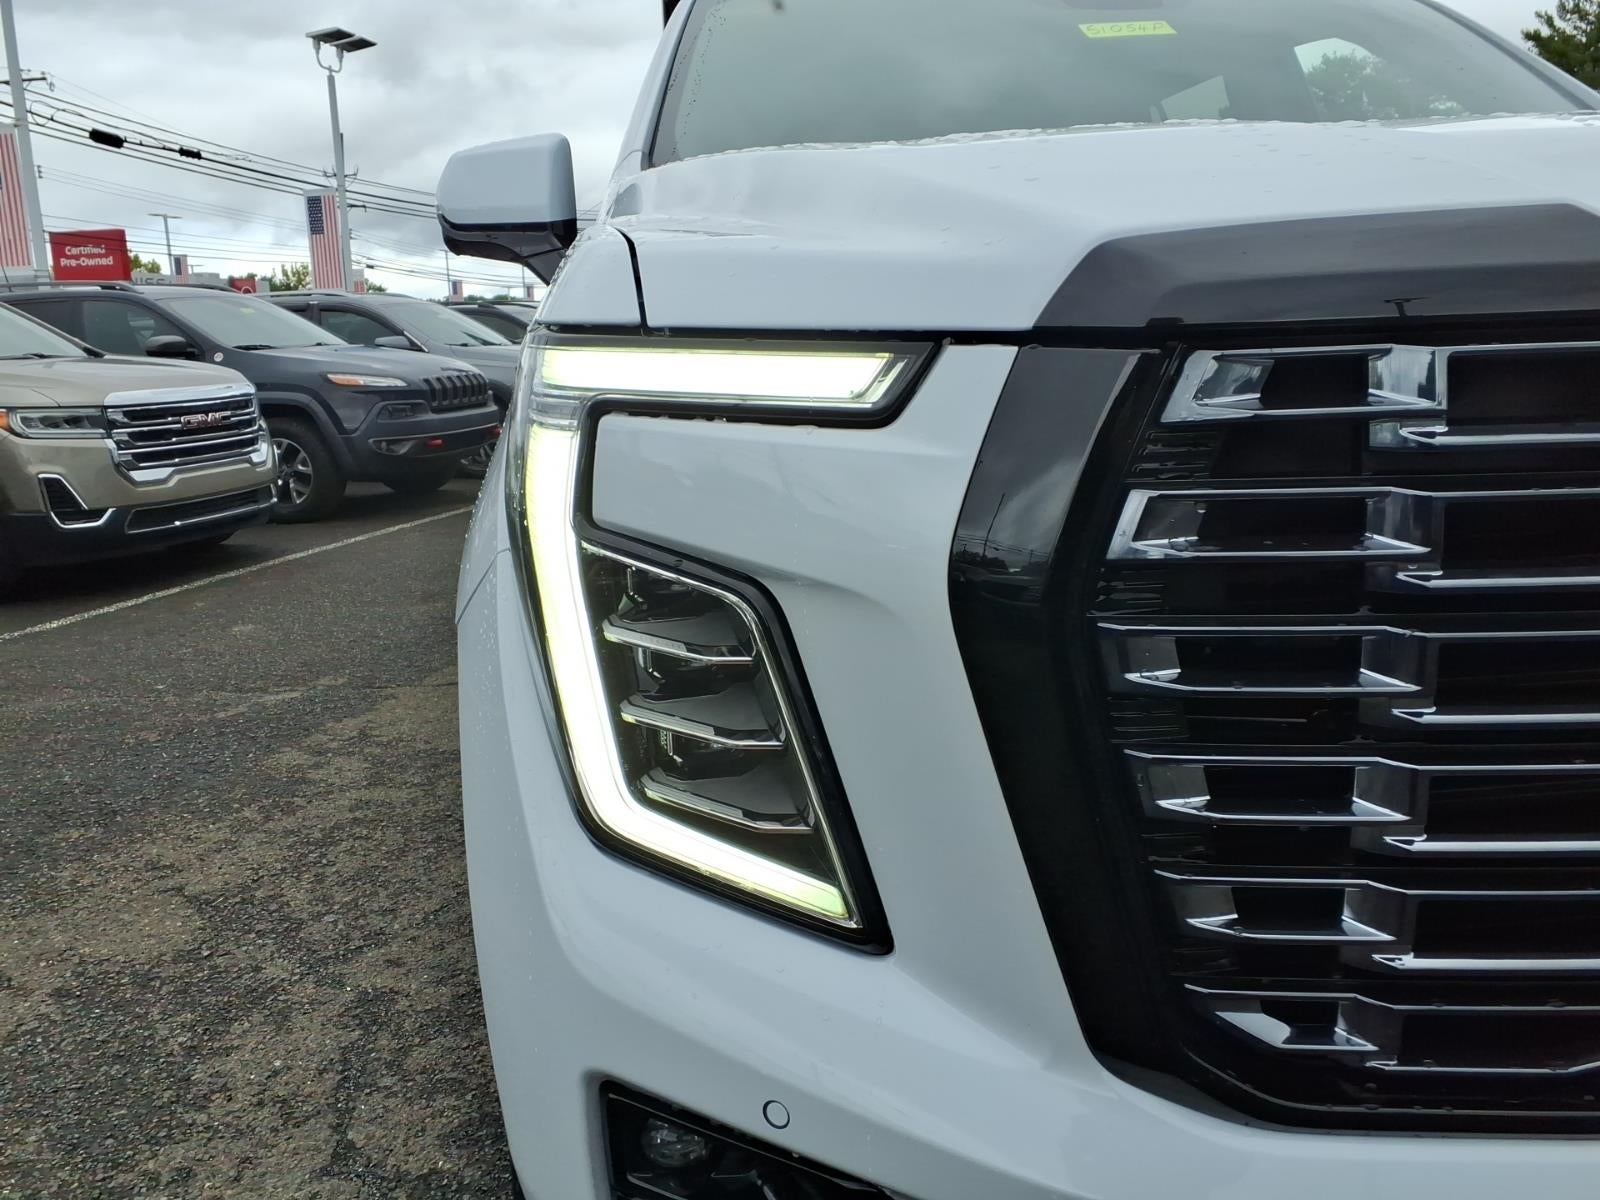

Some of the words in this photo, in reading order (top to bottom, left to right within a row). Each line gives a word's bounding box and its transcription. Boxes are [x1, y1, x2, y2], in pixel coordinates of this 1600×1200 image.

[65, 244, 106, 255] Certified
[60, 256, 114, 267] Pre-Owned
[180, 410, 231, 430] GMC
